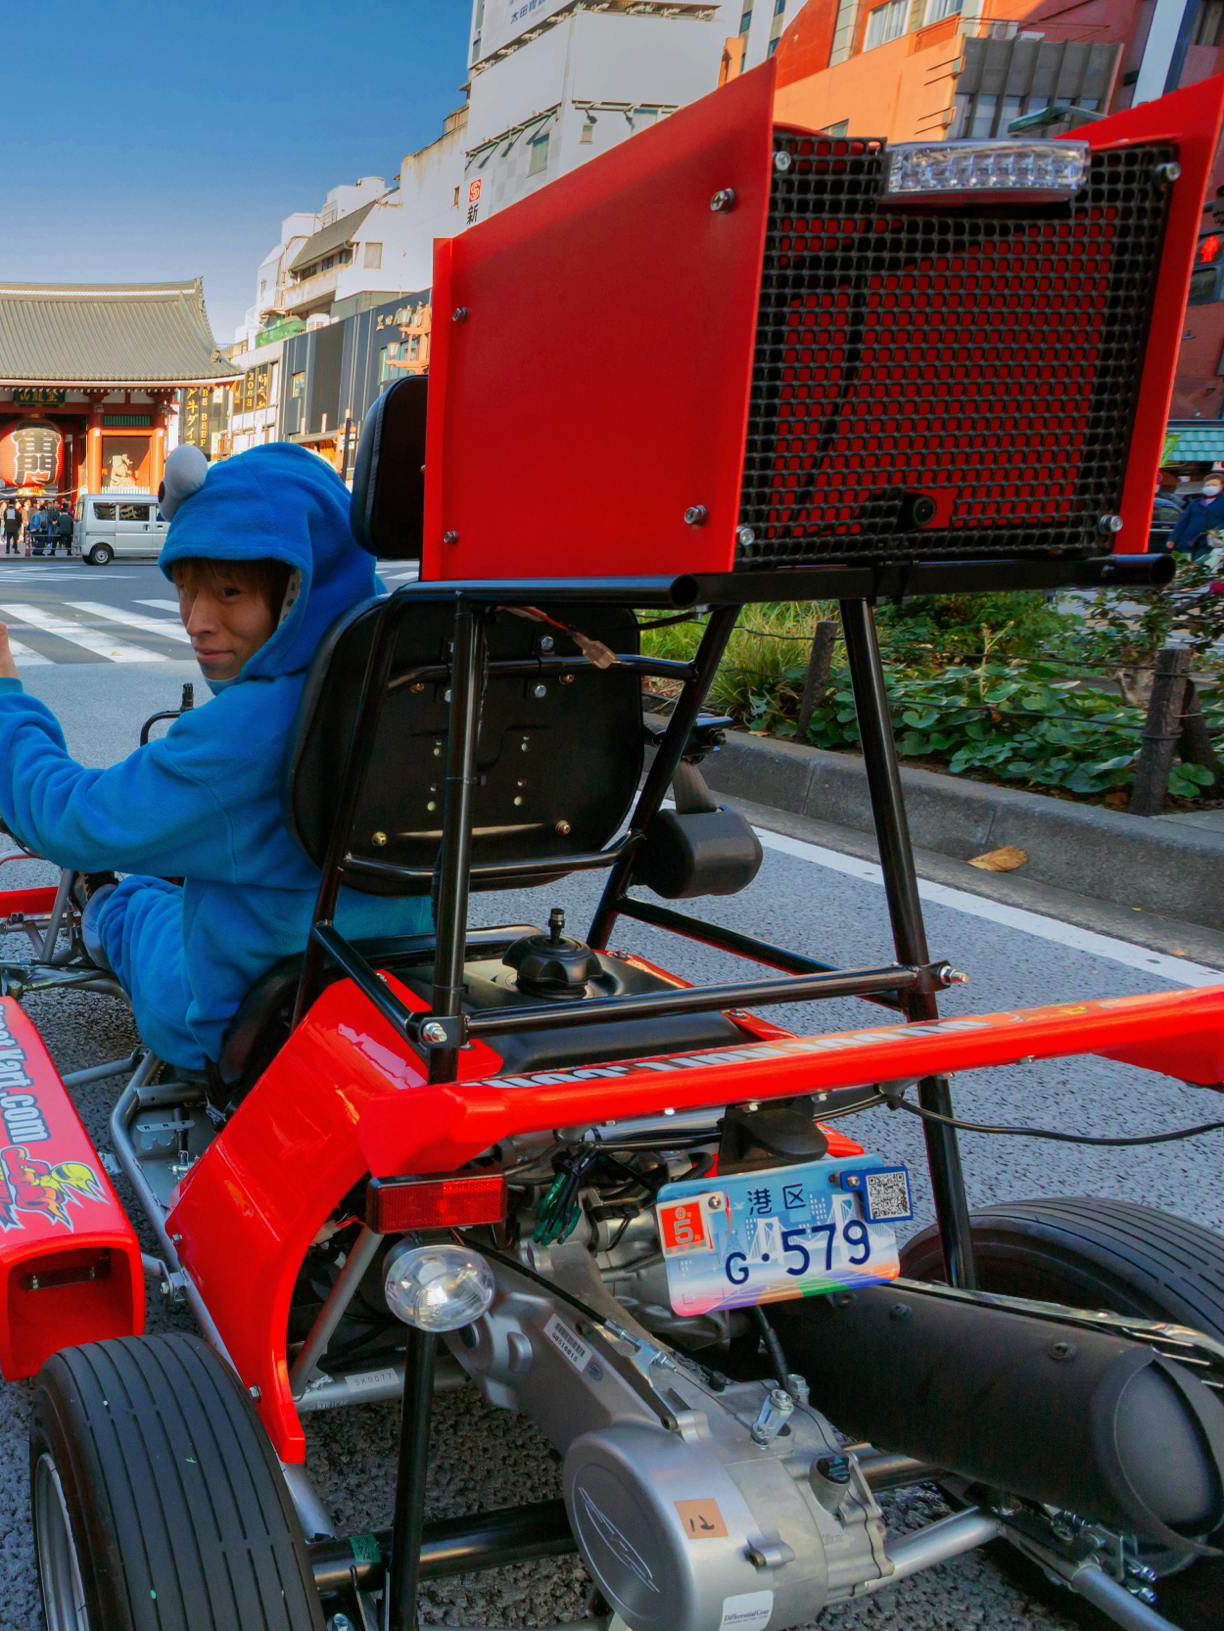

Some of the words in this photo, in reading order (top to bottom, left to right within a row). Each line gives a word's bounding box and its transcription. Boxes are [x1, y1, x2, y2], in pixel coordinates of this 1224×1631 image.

[200, 413, 208, 447] BEEF
[747, 1183, 807, 1215] 港区
[674, 1220, 695, 1244] 5
